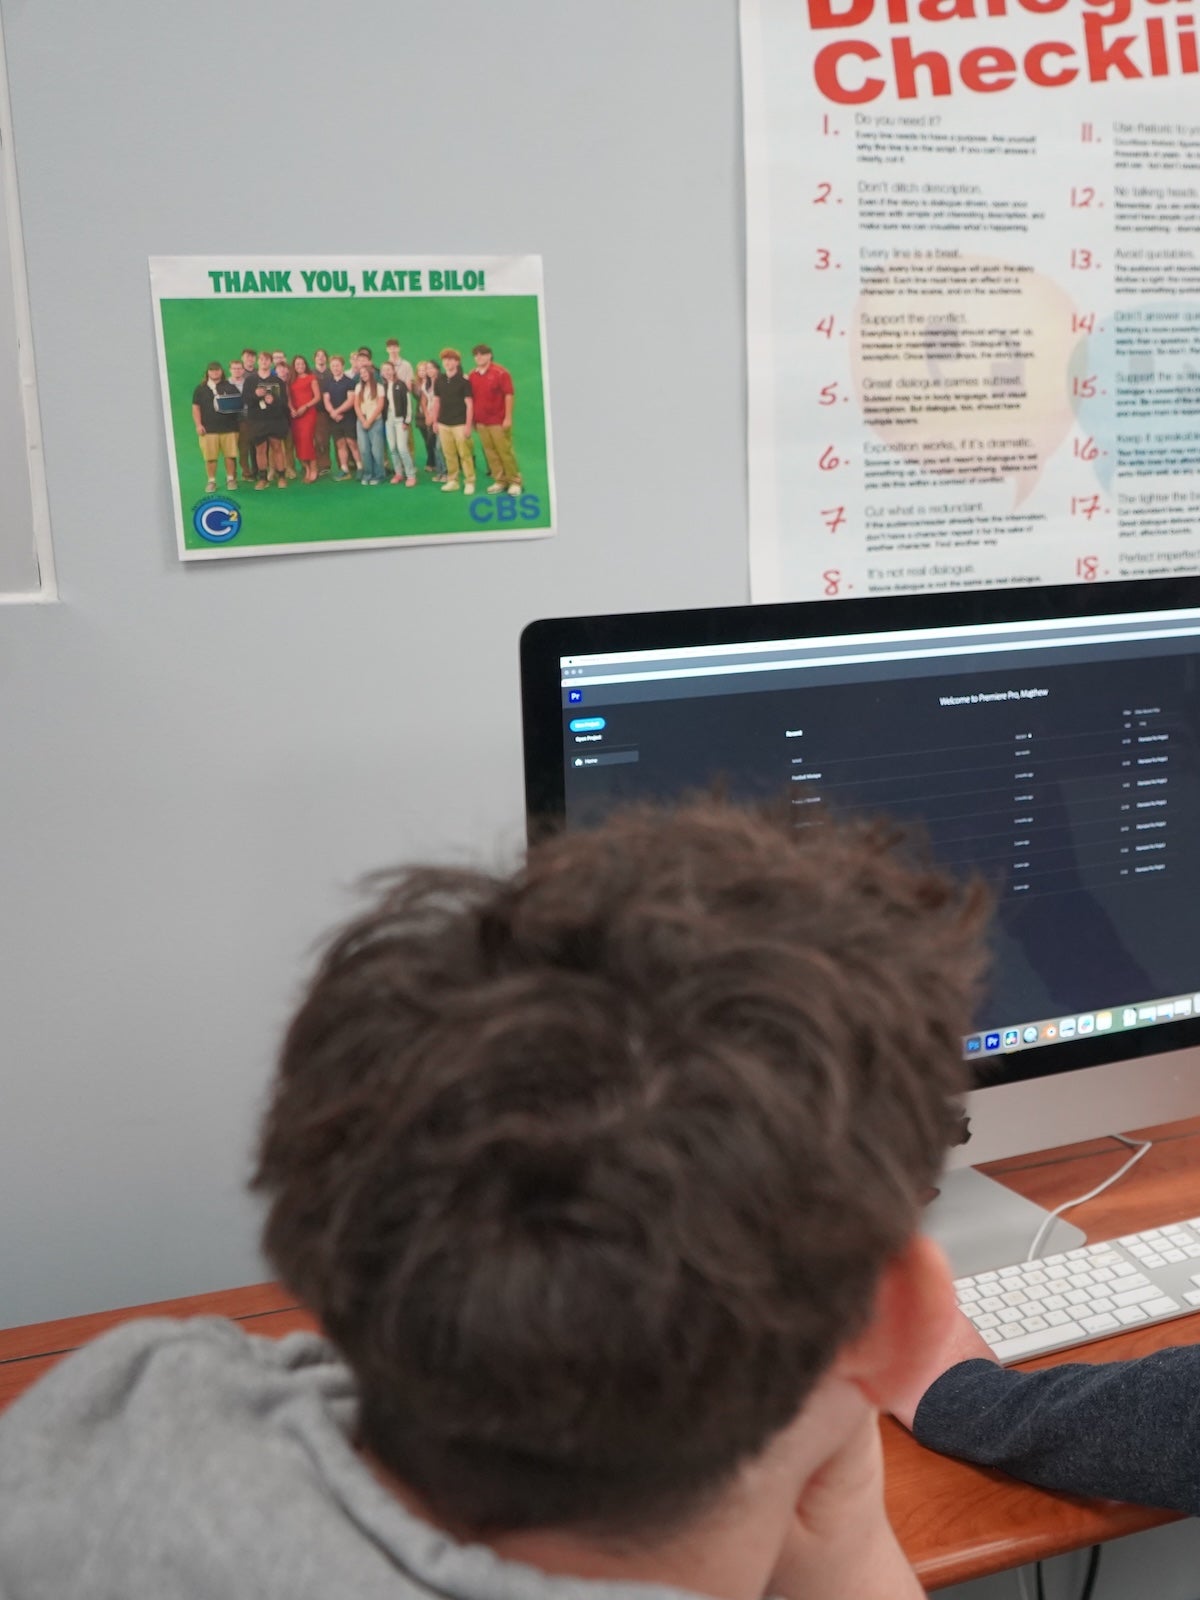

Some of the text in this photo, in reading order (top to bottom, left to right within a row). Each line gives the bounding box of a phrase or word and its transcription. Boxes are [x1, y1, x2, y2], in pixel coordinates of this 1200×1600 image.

[823, 113, 839, 136] 1.
[855, 113, 872, 125] Do
[874, 117, 895, 128] you
[897, 114, 926, 126] need
[813, 182, 843, 204] 2.
[858, 181, 888, 193] Don't
[1071, 186, 1104, 208] 12.
[814, 248, 841, 270] 3.
[860, 248, 889, 261] Every
[891, 248, 911, 258] line
[1071, 249, 1101, 269] 13.
[208, 270, 485, 297] THANK YOU, KATE BILO!
[816, 315, 846, 339] 4.
[860, 312, 967, 326] Support the conflict.
[1071, 313, 1104, 334] 14.
[818, 382, 849, 405] 5.
[862, 378, 893, 389] Great
[895, 378, 941, 391] dialogue
[1073, 376, 1106, 398] 15.
[818, 445, 851, 471] 6.
[864, 441, 919, 455] Exposition
[1074, 436, 1108, 461] 16.
[468, 494, 541, 524] CBS
[864, 505, 884, 517] Cut
[886, 505, 914, 516] what
[916, 504, 926, 515] is
[1071, 494, 1111, 520] 17.
[868, 567, 884, 579] It's
[885, 566, 904, 578] not
[1076, 555, 1110, 581] 18.
[823, 569, 854, 595] 8.
[570, 692, 581, 700] Pr
[939, 696, 970, 706] Welcome
[971, 695, 978, 703] to
[979, 693, 1007, 702] Premiere
